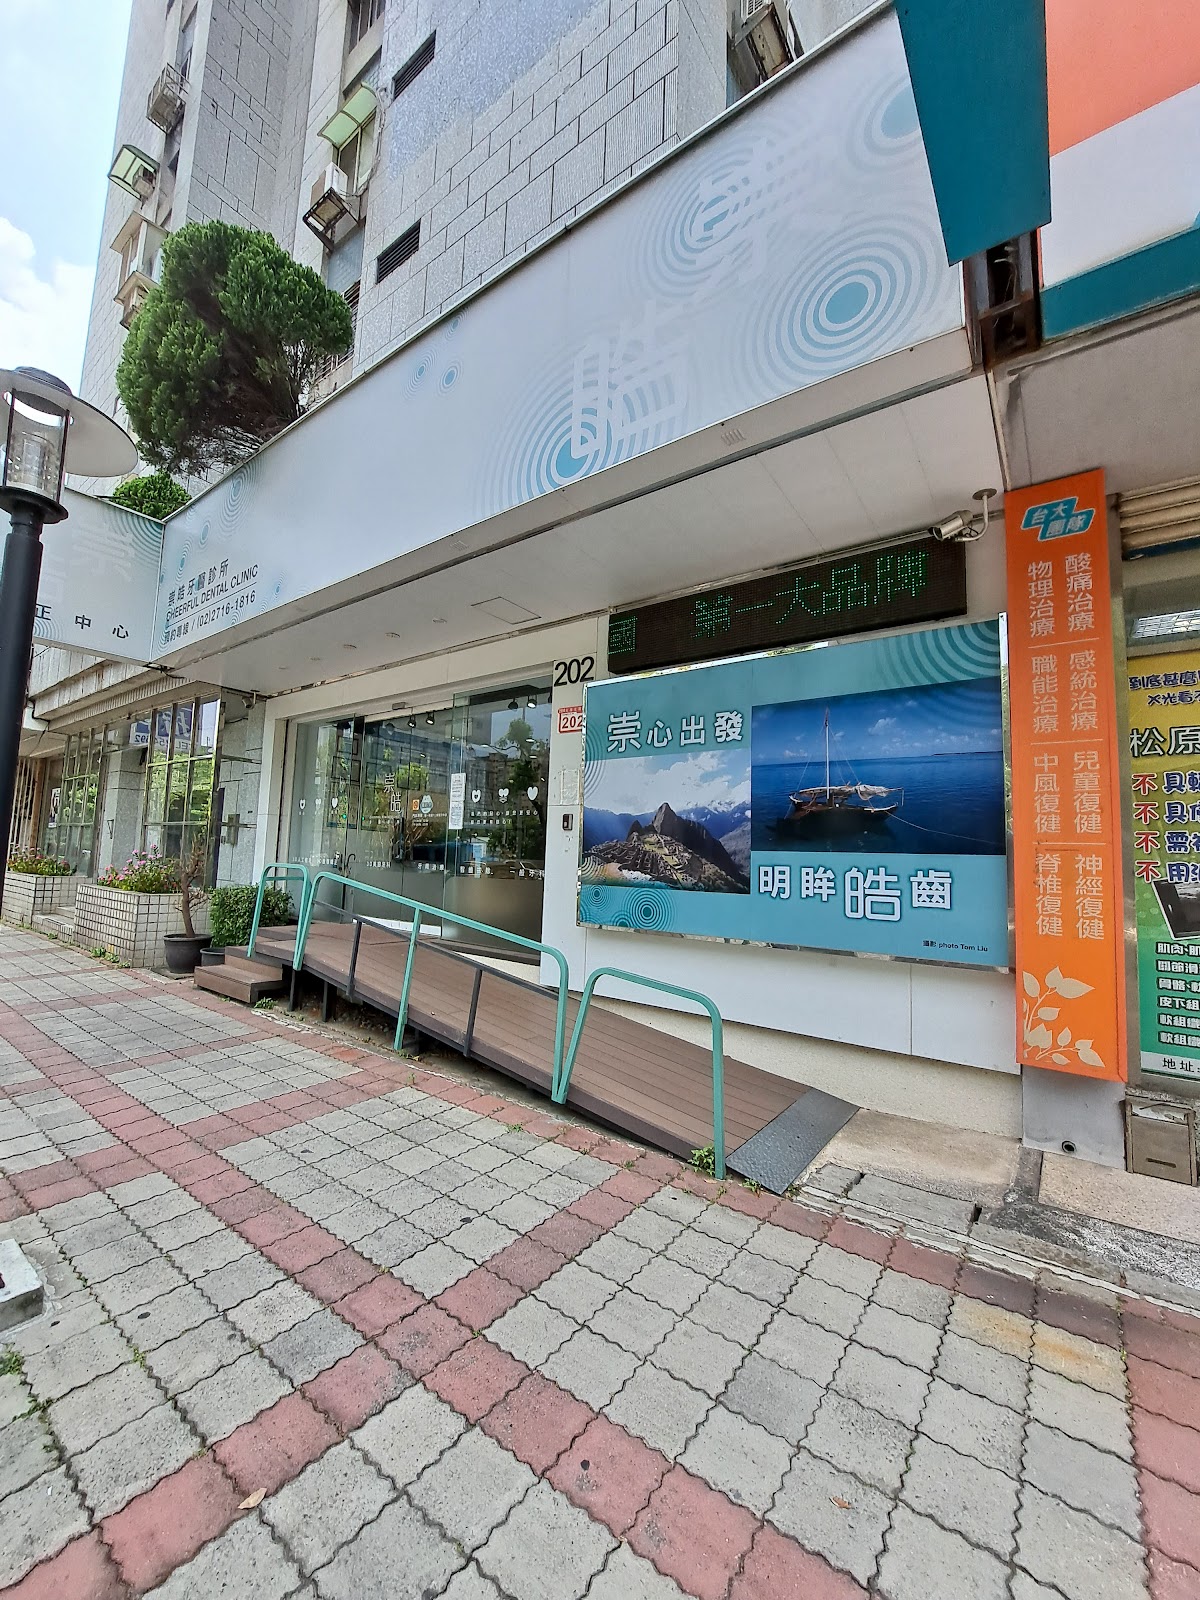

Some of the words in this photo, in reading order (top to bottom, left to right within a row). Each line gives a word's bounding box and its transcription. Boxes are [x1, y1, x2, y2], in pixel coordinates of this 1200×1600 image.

[166, 596, 200, 623] CHEERFUL
[200, 580, 229, 605] DENTAL
[230, 564, 259, 589] CLINIC
[1028, 559, 1055, 639] 物理治療
[1065, 551, 1096, 633] 酸痛治療
[554, 656, 595, 687] 202
[1031, 654, 1059, 735] 職能治療
[1069, 649, 1099, 732] 感統治療
[607, 710, 744, 752] 崇心出發
[1033, 752, 1062, 834] 中風復健
[1072, 750, 1103, 834] 兒童復健
[758, 865, 953, 923] 明眸皓齒
[1035, 853, 1063, 937] 脊椎復健
[1075, 853, 1105, 940] 神經復健
[960, 943, 976, 951] Tom
